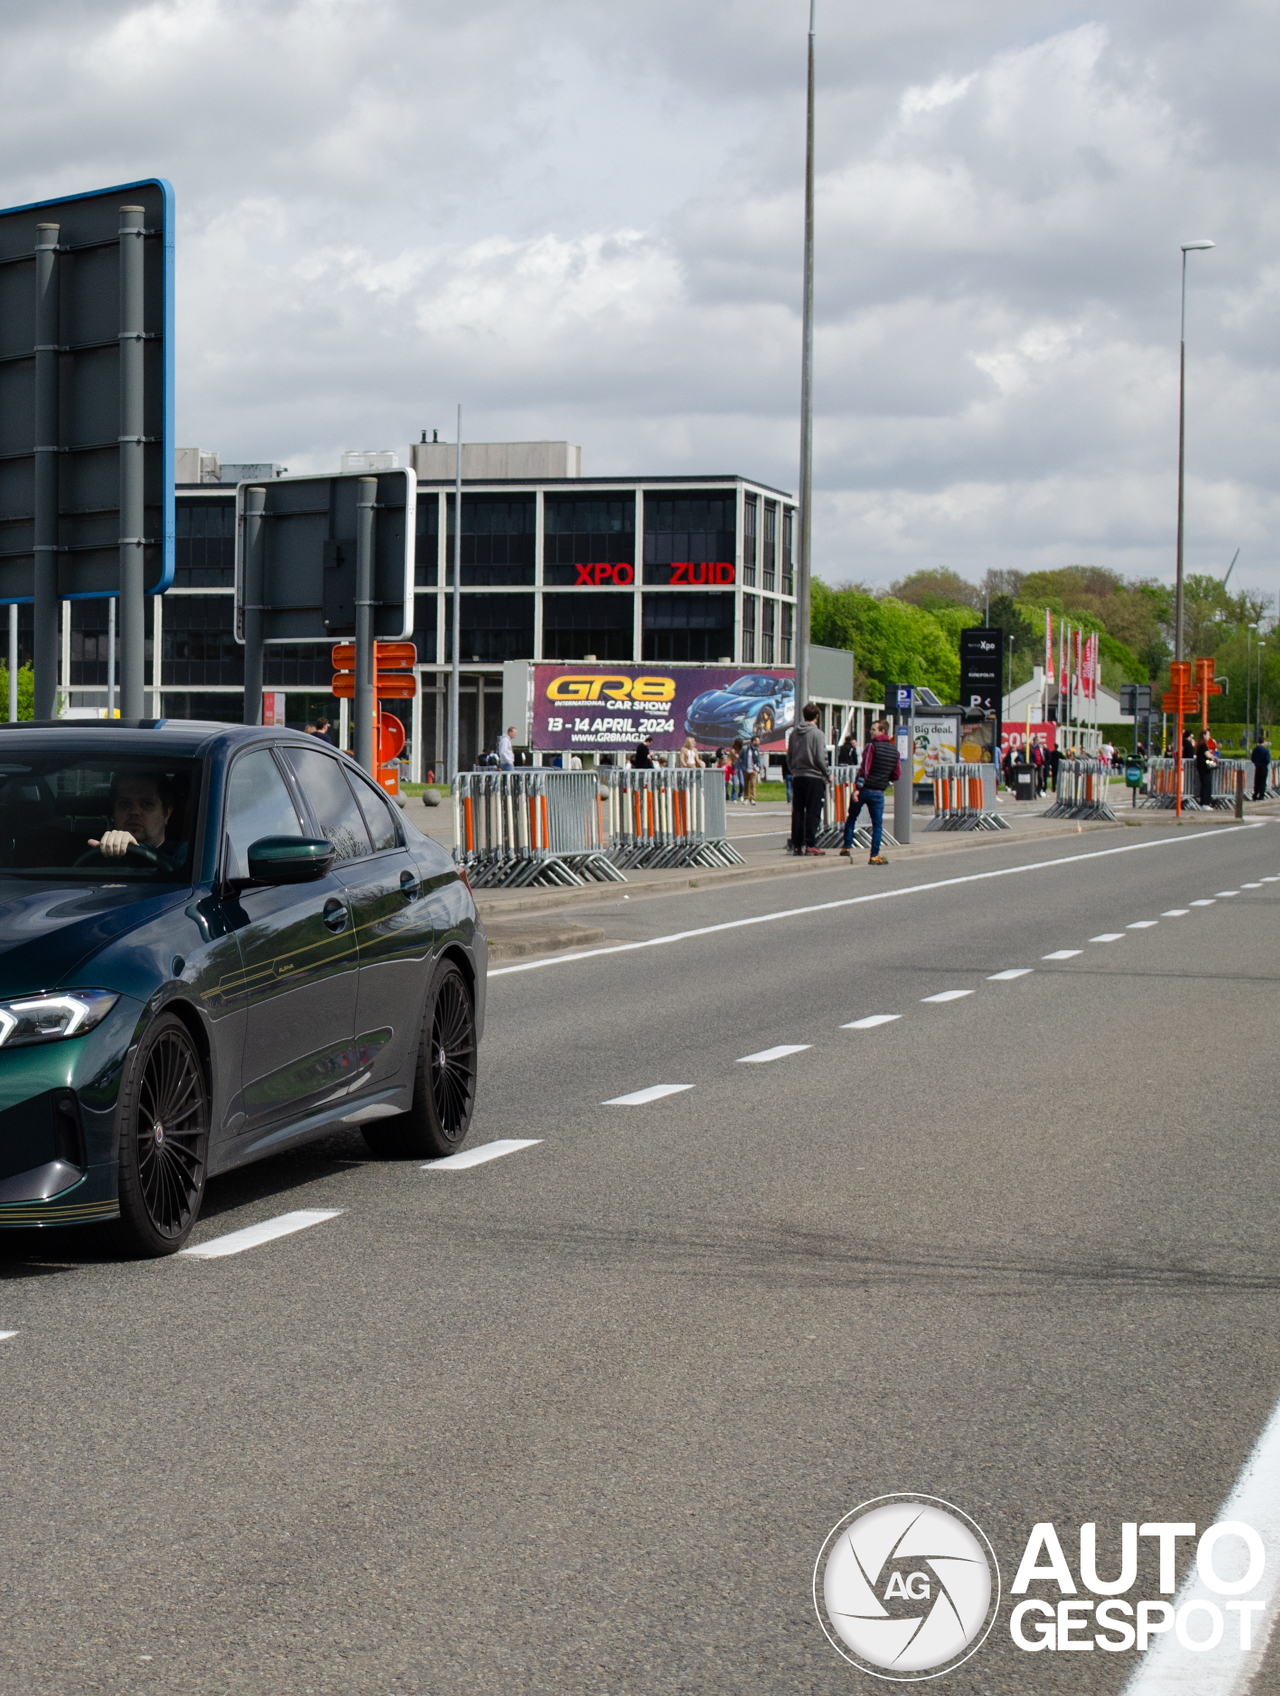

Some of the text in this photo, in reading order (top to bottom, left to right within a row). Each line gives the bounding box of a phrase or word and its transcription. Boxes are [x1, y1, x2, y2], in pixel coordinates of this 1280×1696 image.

[575, 562, 735, 586] XPO ZUID
[546, 674, 676, 702] GR8
[897, 689, 908, 701] P
[606, 700, 632, 710] CAR
[633, 700, 671, 711] SHOW
[970, 694, 981, 708] P
[547, 717, 563, 732] 13
[574, 717, 590, 732] 14
[591, 717, 637, 732] APRIL
[637, 718, 675, 733] 2024
[914, 725, 929, 735] Big
[931, 725, 953, 735] deal.
